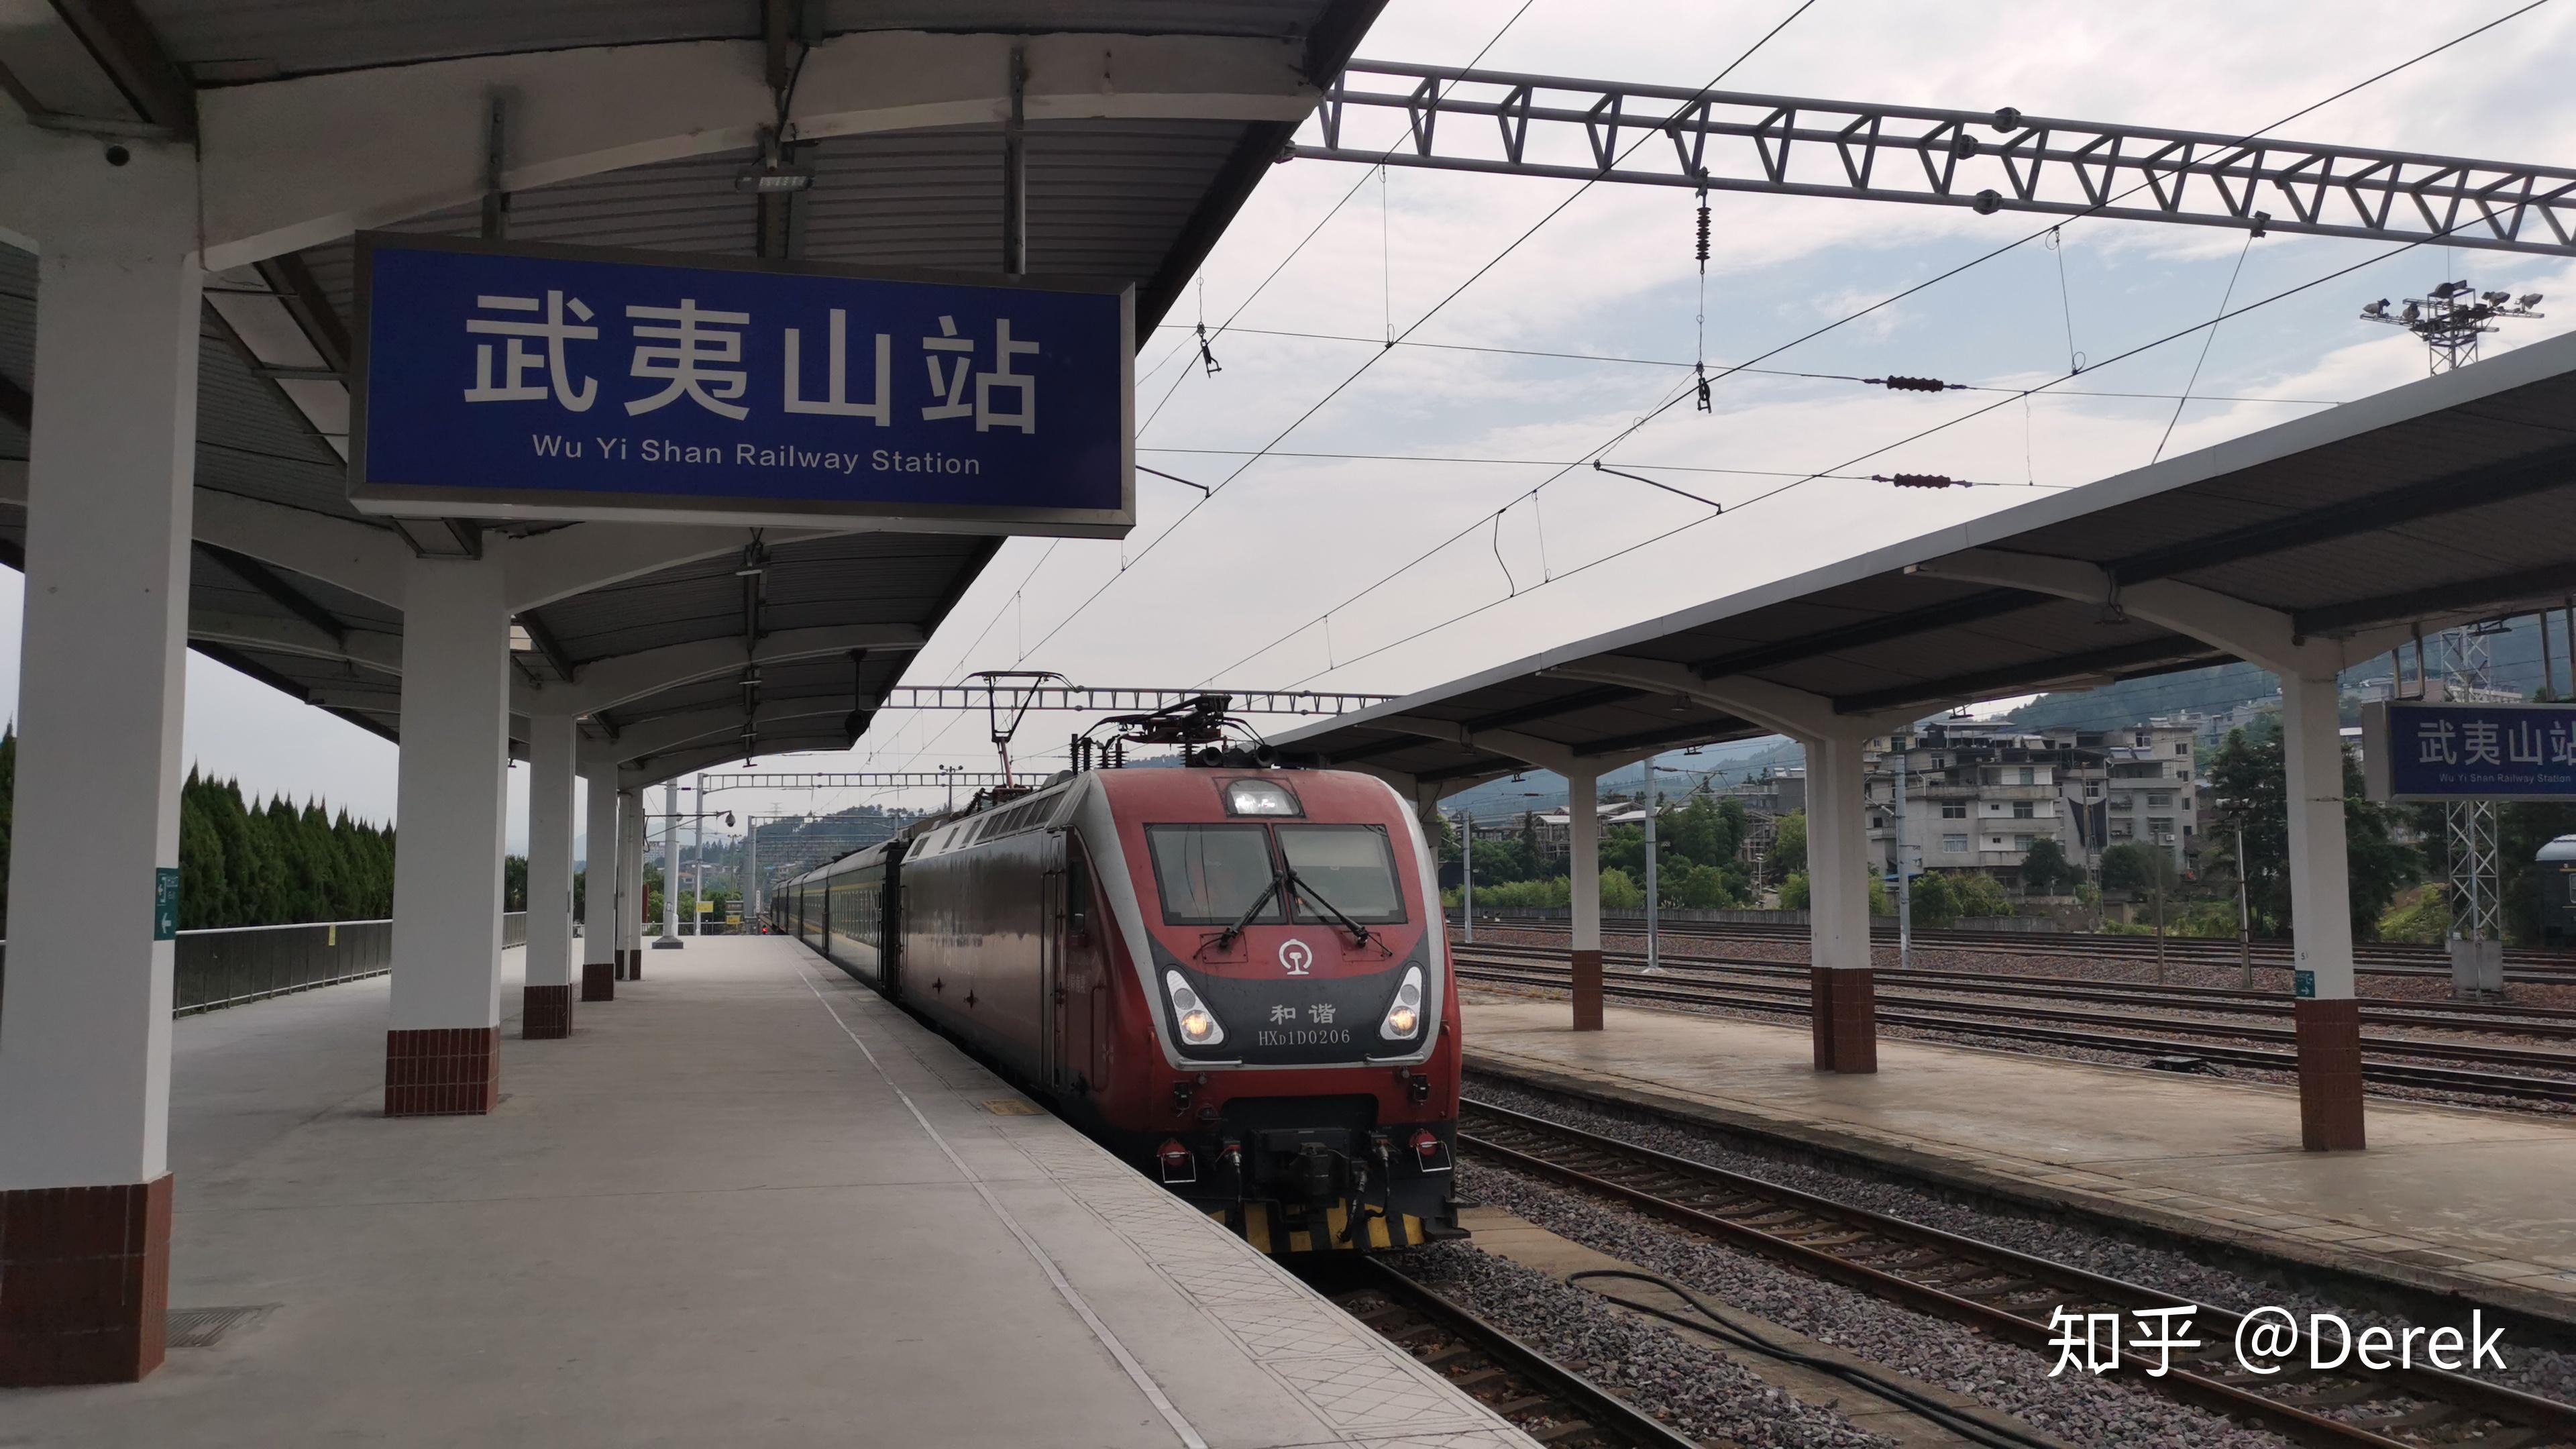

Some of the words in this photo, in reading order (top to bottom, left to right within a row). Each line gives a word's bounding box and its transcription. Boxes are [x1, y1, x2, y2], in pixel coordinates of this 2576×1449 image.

[464, 290, 1040, 434] 武夷山站
[533, 434, 583, 459] Wu
[597, 437, 627, 461] Yi
[641, 439, 721, 464] Shan
[737, 444, 859, 475] Railway
[871, 449, 981, 475] Station
[2417, 719, 2576, 766] 武夷山站
[2439, 773, 2454, 783] Wu
[2459, 773, 2468, 783] Yi
[2470, 773, 2495, 783] Shan
[2497, 773, 2534, 784] Railway
[2537, 773, 2571, 784] Station
[1269, 1002, 1336, 1025] 和谐
[1258, 1029, 1350, 1046] HXD1D0206
